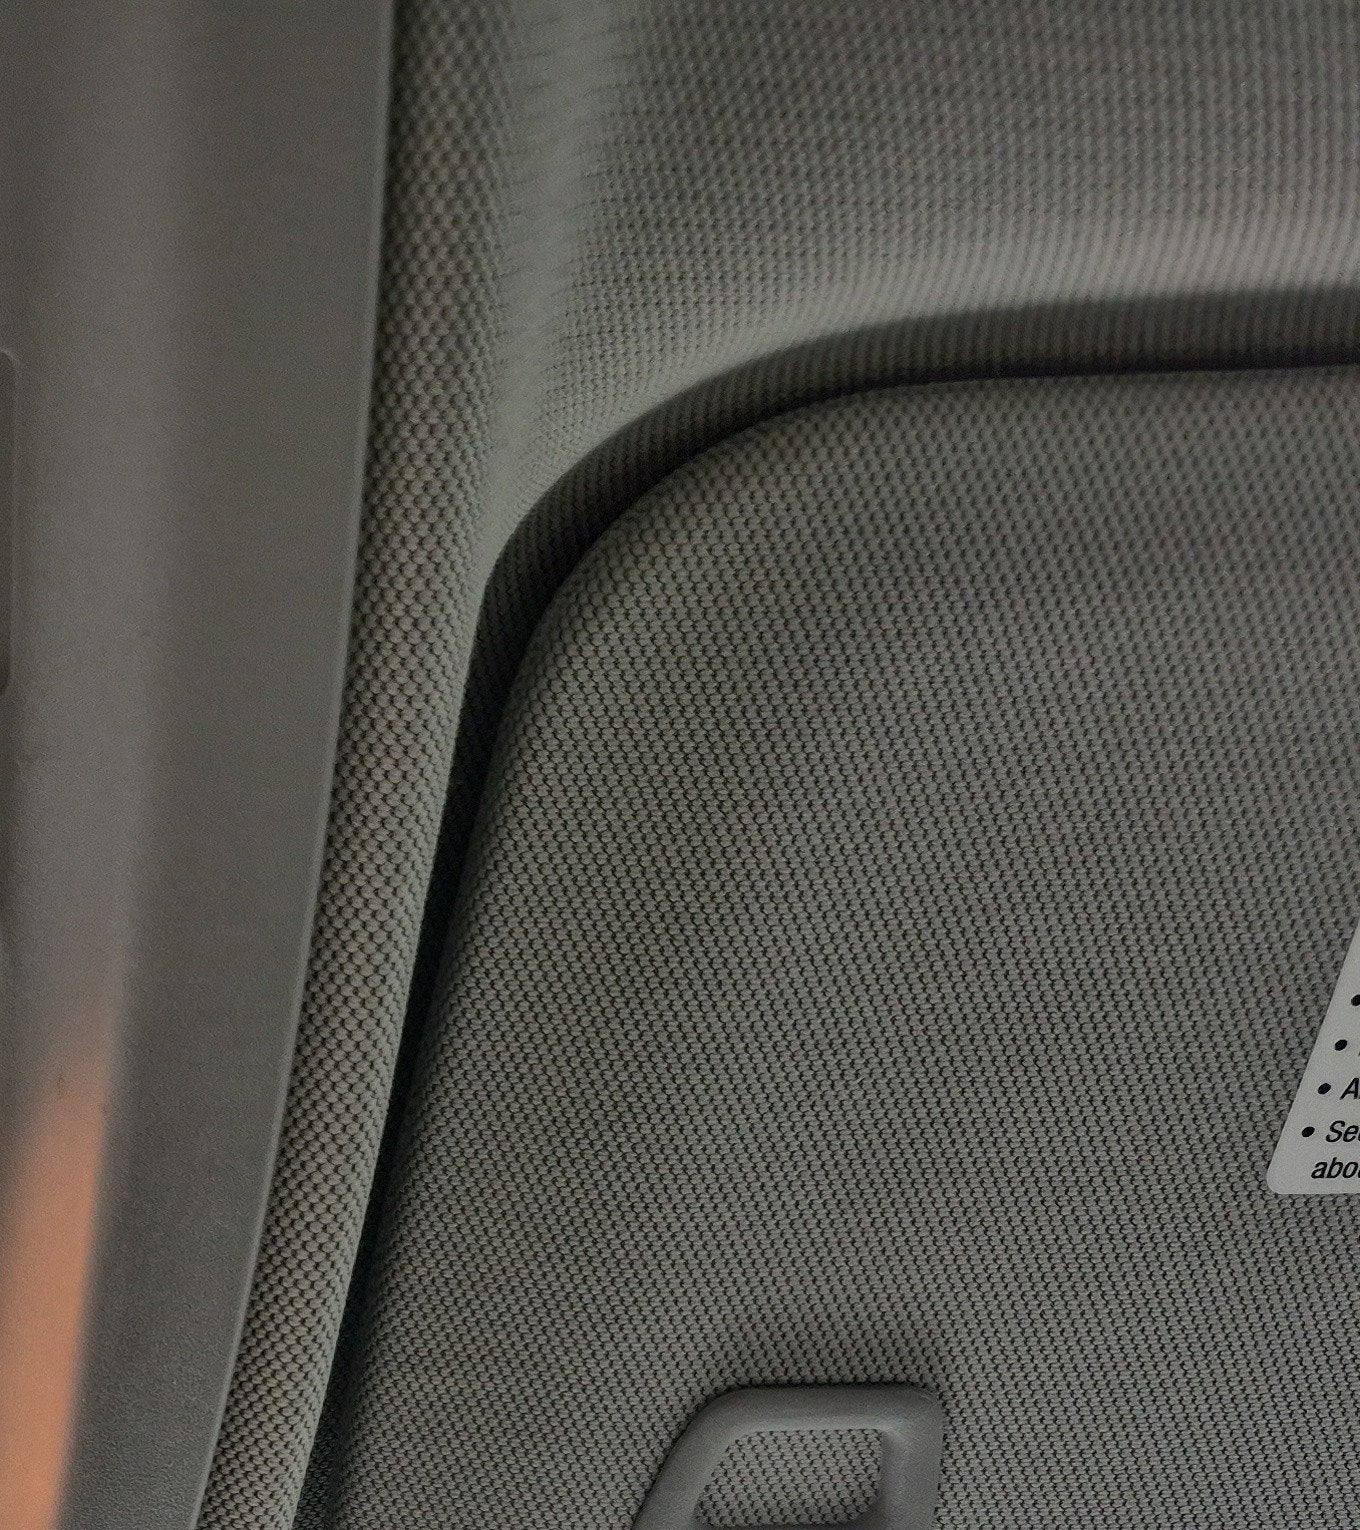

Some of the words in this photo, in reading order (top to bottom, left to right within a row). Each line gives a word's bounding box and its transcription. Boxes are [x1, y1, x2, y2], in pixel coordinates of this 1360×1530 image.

[1340, 1077, 1360, 1100] A
[1325, 1120, 1360, 1143] Se
[1311, 1157, 1360, 1180] abo
